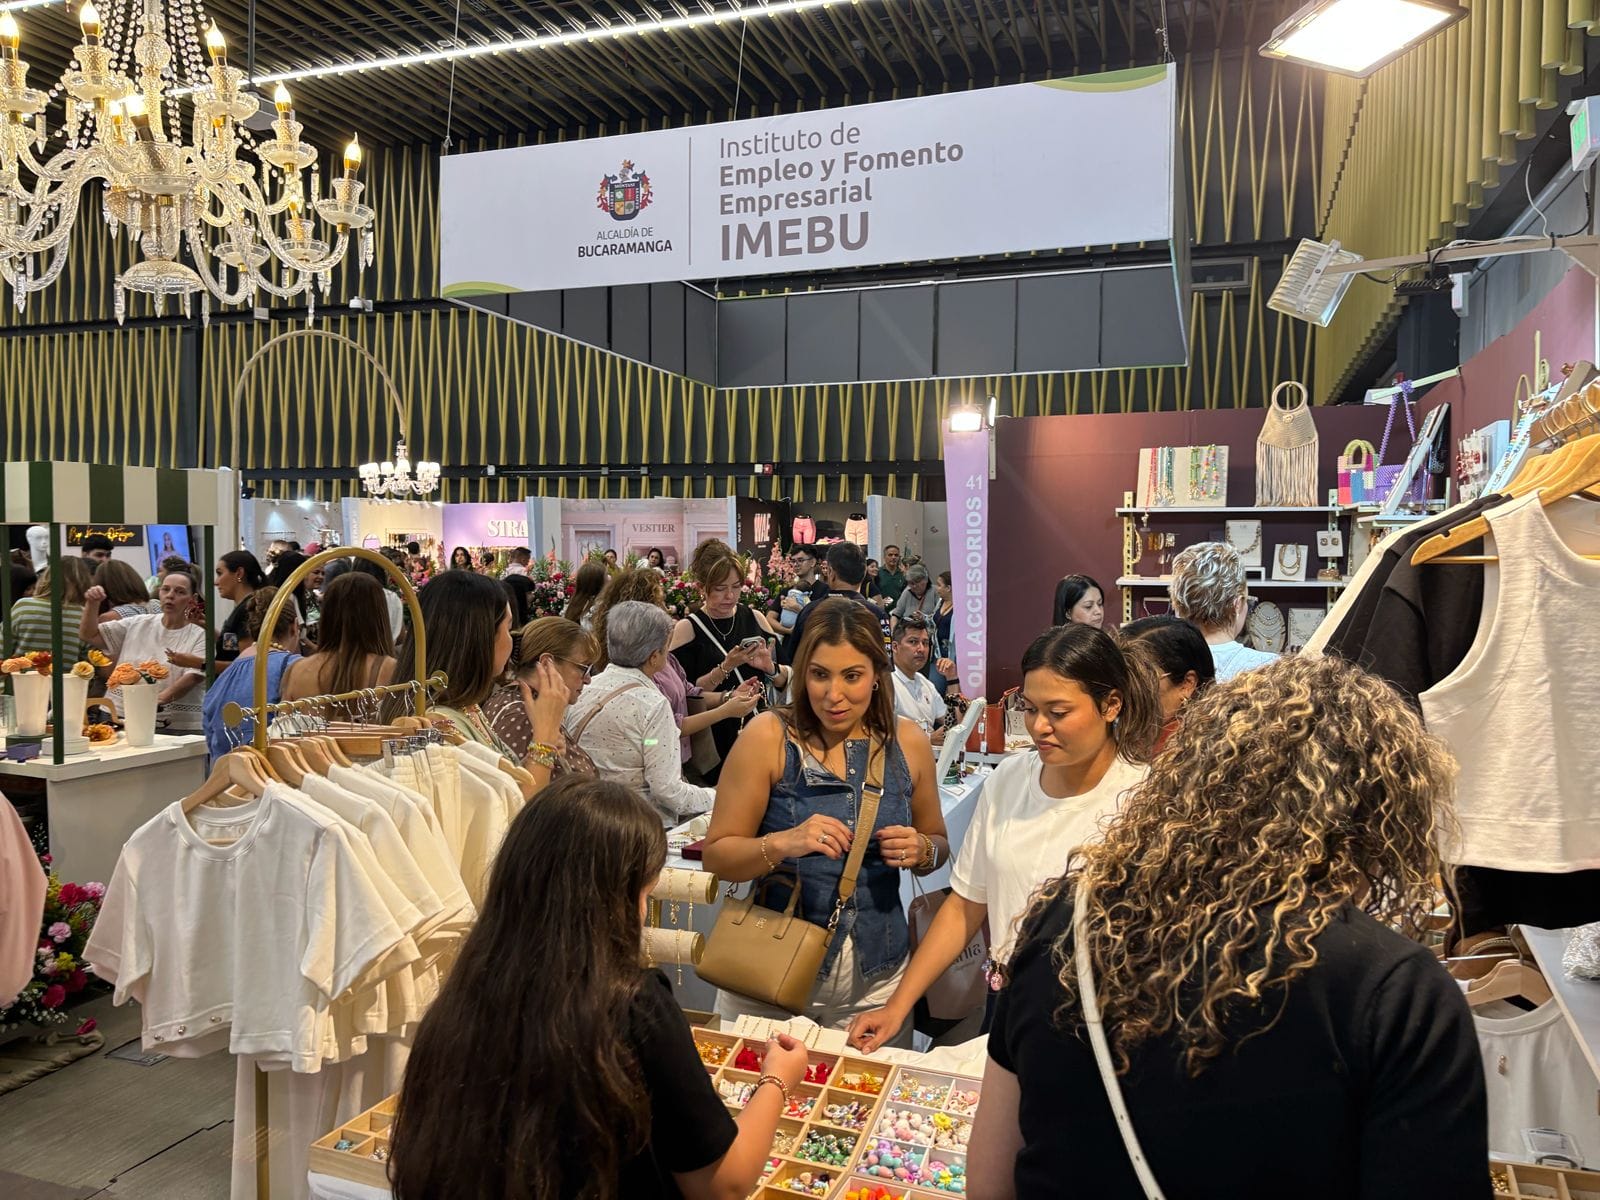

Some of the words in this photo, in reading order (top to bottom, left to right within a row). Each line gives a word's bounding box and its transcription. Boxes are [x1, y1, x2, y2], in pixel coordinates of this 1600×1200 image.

[720, 128, 822, 159] Instituto
[830, 121, 860, 146] de
[720, 158, 813, 188] Empleo
[820, 158, 836, 182] y
[844, 142, 963, 174] Fomento
[720, 177, 872, 217] Empresarial
[578, 240, 673, 258] BUCARAMANGA
[596, 226, 639, 240] ALCALDÍA
[641, 227, 653, 237] DE
[721, 211, 869, 261] IMEBU
[966, 474, 982, 490] 41
[632, 523, 676, 533] VESTIER
[966, 496, 983, 646] ACCESORIOS
[967, 651, 983, 688] OLI
